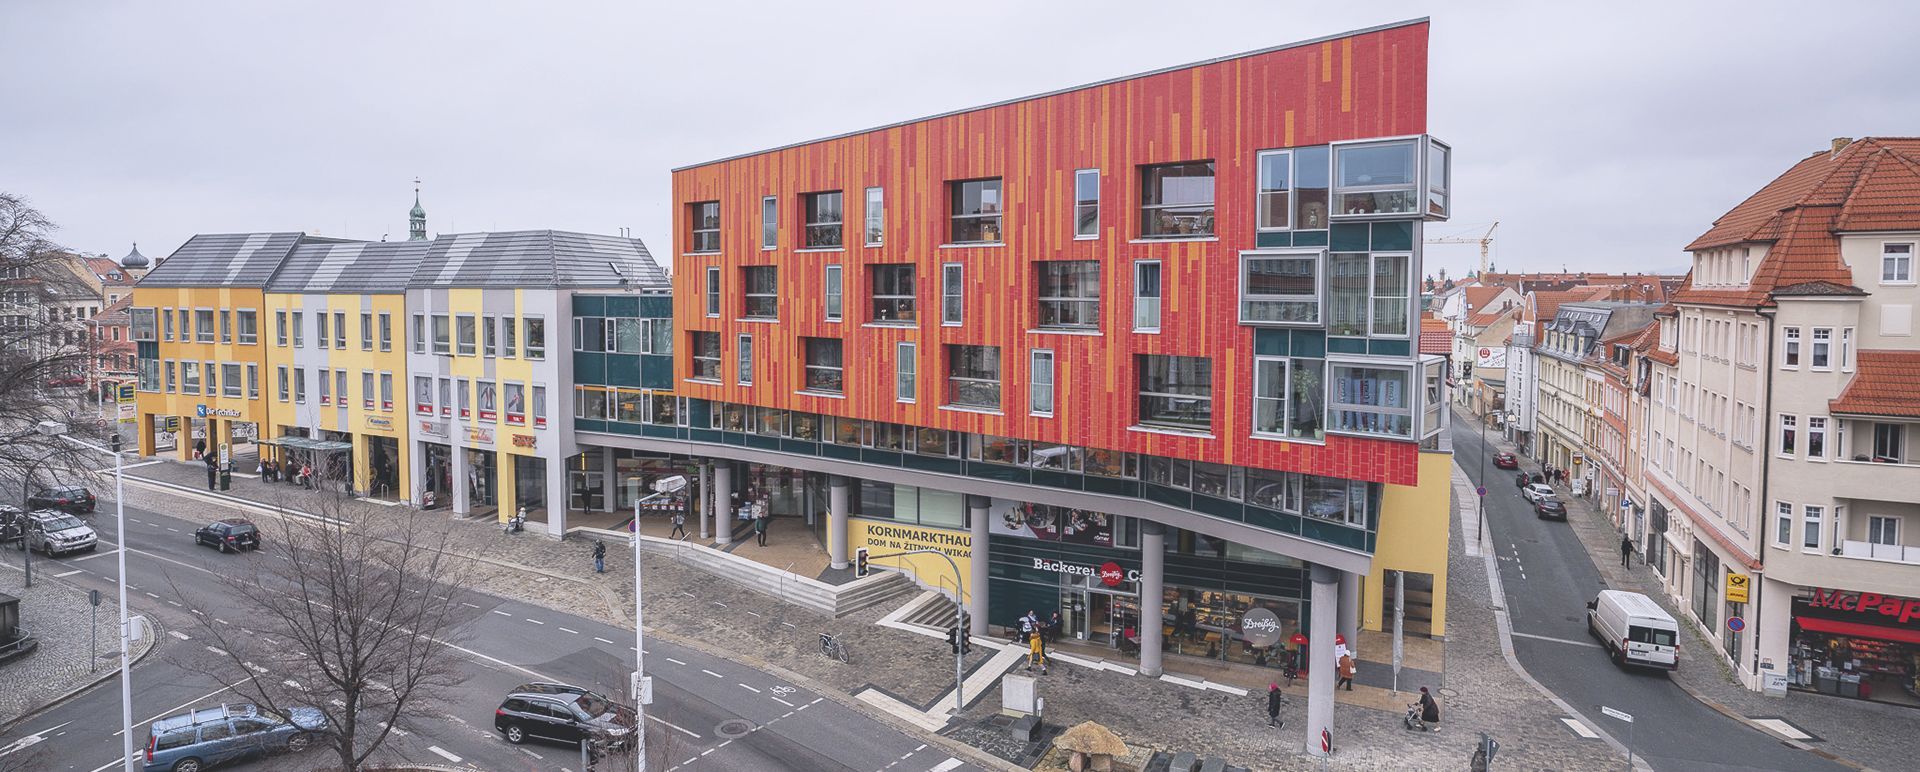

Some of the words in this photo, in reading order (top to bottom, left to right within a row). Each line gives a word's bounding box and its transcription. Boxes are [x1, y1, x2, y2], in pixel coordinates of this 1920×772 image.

[867, 524, 972, 547] KORNMARKTHAU
[867, 538, 887, 547] DOM
[889, 541, 902, 549] NA
[1033, 557, 1096, 577] Bäckerei
[1243, 618, 1280, 633] Dreißig
